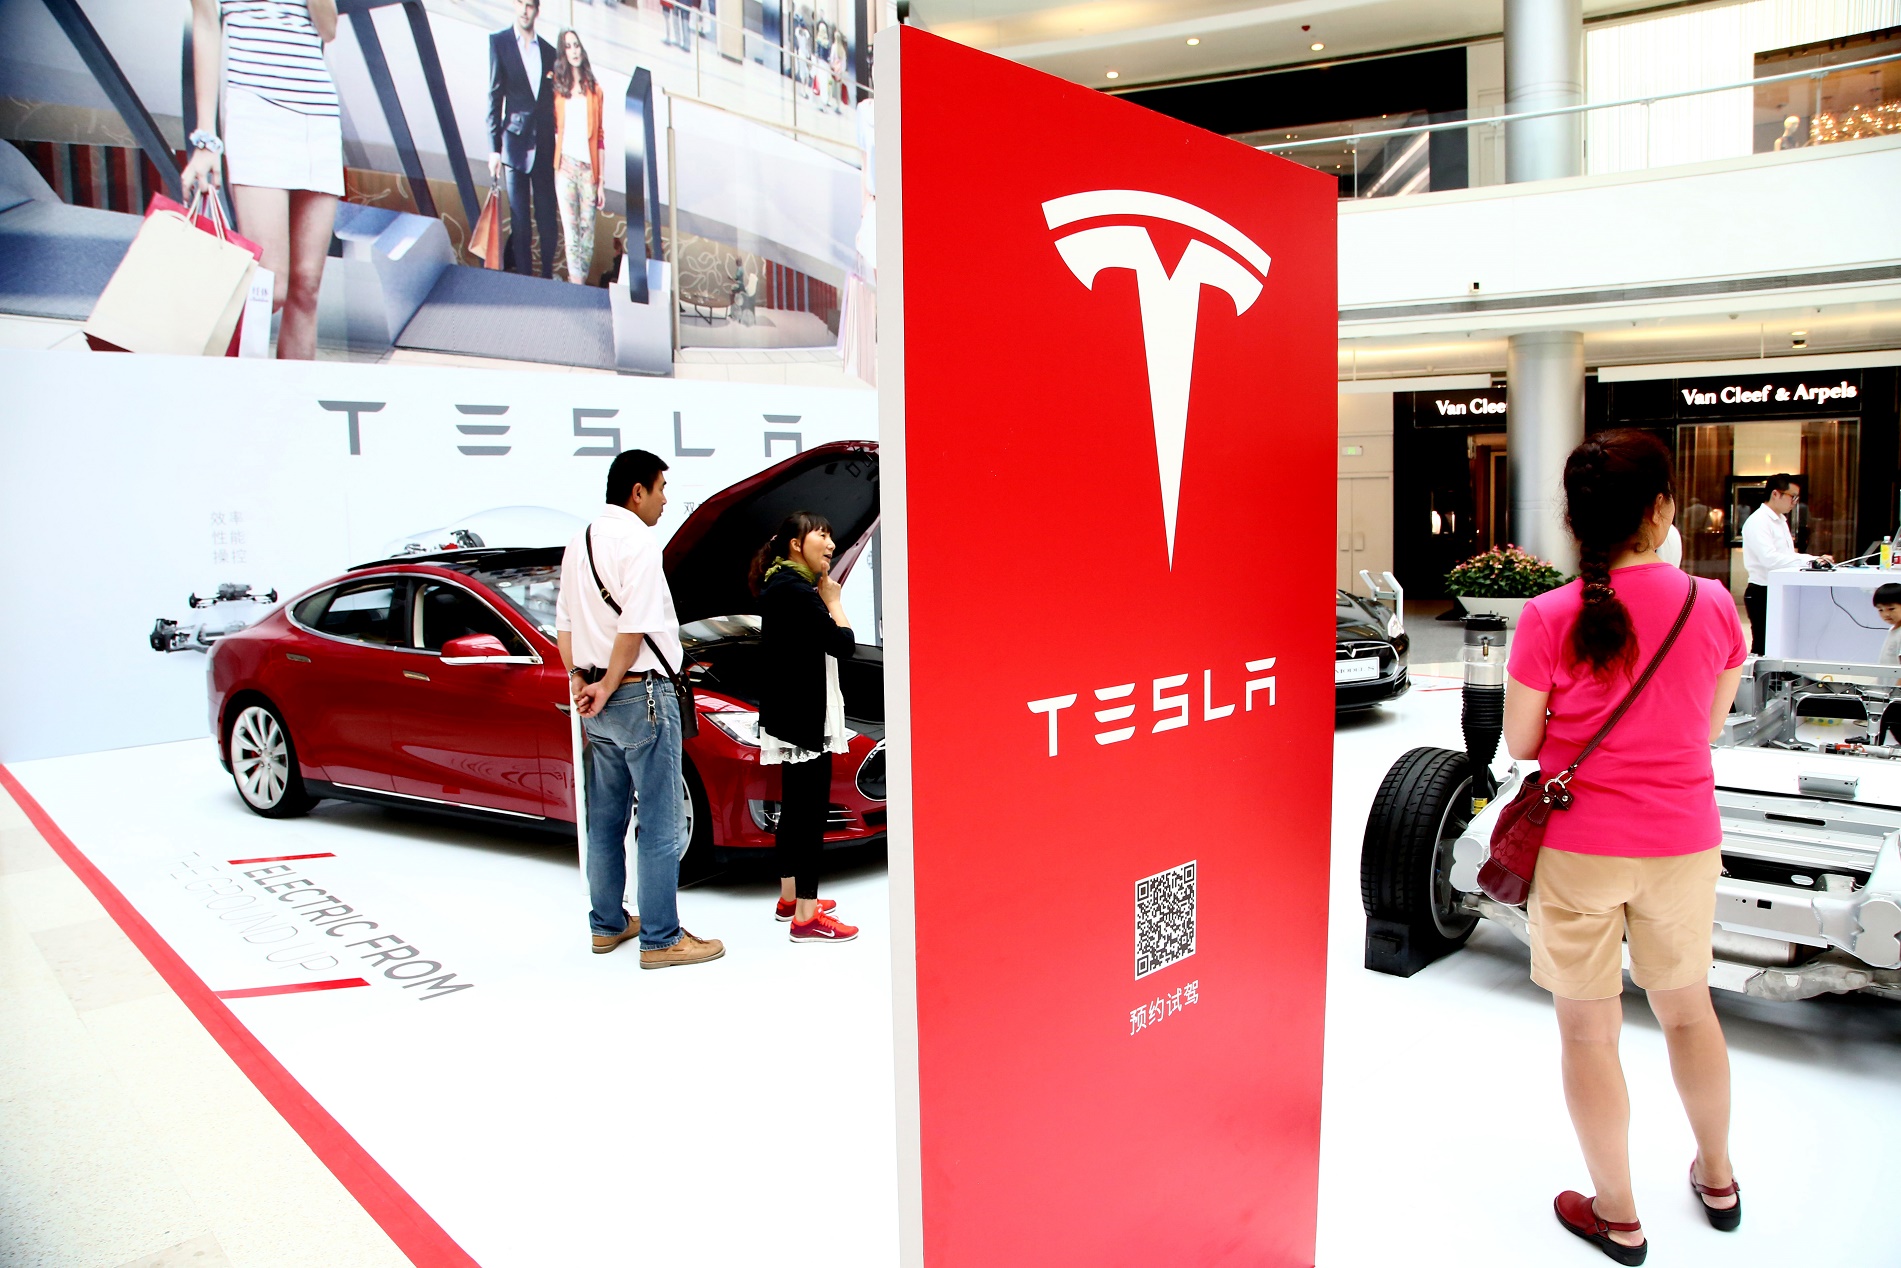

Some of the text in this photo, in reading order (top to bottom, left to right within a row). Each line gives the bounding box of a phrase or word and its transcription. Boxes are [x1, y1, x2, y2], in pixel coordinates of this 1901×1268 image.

[1435, 397, 1508, 416] Van Clee
[1681, 381, 1858, 406] Van Cleef & Arpels
[317, 400, 803, 457] TESLA
[1027, 656, 1277, 758] TESLA
[184, 877, 299, 944] GROUND
[265, 942, 339, 972] UP
[243, 864, 475, 1001] ELECTRIC FROM
[1129, 979, 1200, 1037] 预约试驾
